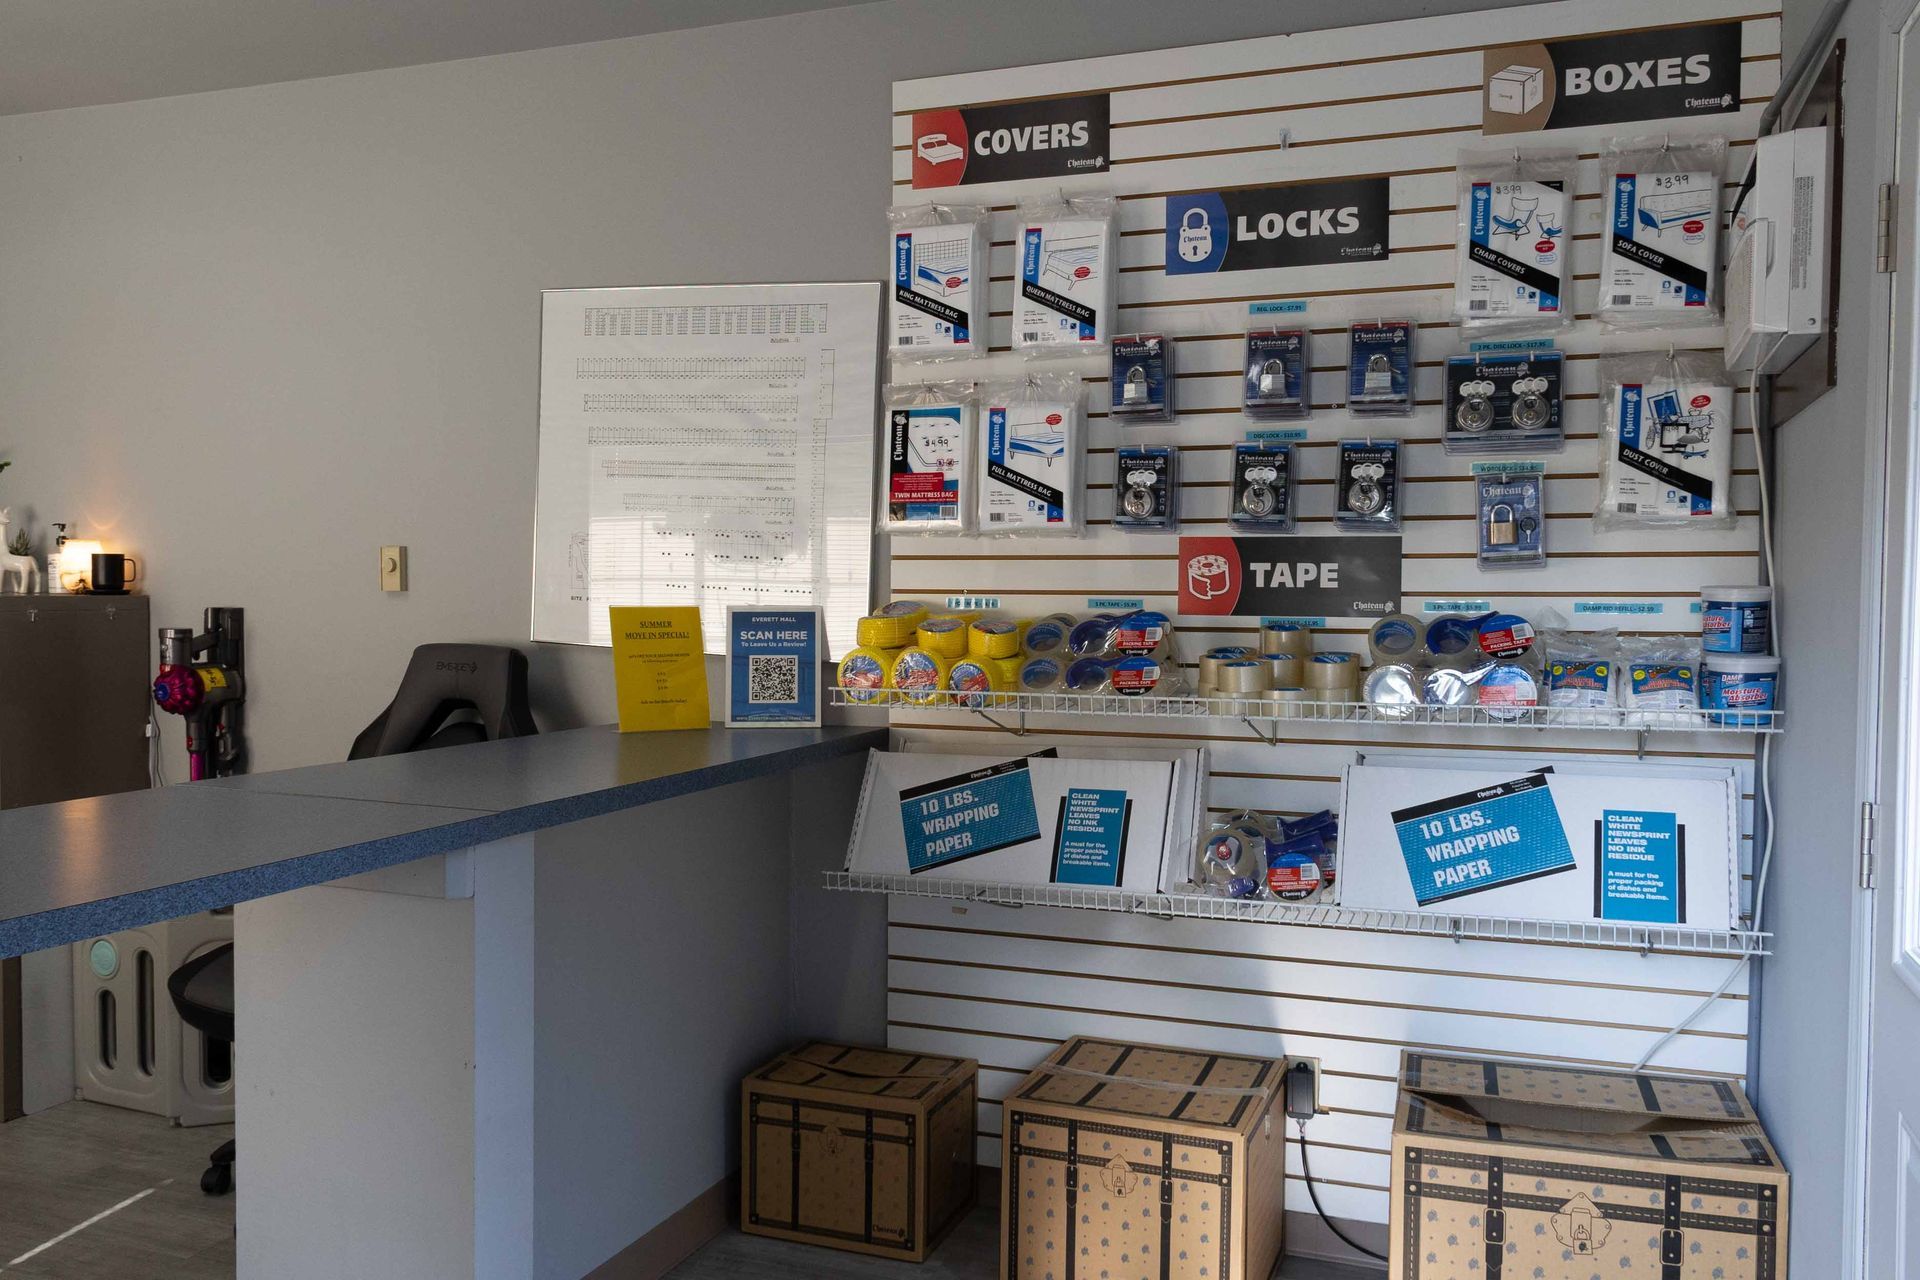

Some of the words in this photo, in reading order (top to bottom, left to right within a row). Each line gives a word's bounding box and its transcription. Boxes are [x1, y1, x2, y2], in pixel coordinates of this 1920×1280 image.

[1565, 54, 1712, 97] BOXES
[1685, 97, 1721, 109] Chateau
[974, 120, 1089, 156] COVERS
[1067, 157, 1094, 168] Chateau
[1474, 201, 1484, 236] Chateau
[1618, 192, 1628, 228] Chateau
[1236, 206, 1360, 242] LOCKS
[1026, 246, 1035, 276] Chateau
[1340, 247, 1372, 256] Chateau
[1474, 247, 1496, 261] CHAIR
[1498, 256, 1526, 275] COVERS
[1617, 239, 1637, 253] SOFA
[1640, 248, 1664, 264] COVER
[899, 290, 914, 300] KING
[914, 296, 945, 314] MATTRESS
[945, 307, 958, 319] BAG
[1026, 285, 1044, 298] QUEEN
[1044, 291, 1077, 312] MATTRESS
[1076, 306, 1090, 319] BAG
[1251, 338, 1287, 350] Chateau
[1355, 331, 1392, 343] Chateau
[1115, 346, 1148, 356] Chateau
[1476, 365, 1517, 377] Chateau
[1624, 402, 1634, 437] Chateau
[894, 426, 903, 461] Chateau
[992, 423, 1000, 456] Chateau
[1122, 458, 1154, 467] Chateau
[1240, 455, 1274, 466] Chateau
[1344, 451, 1381, 462] Chateau
[1623, 448, 1643, 462] DUST
[1644, 458, 1669, 474] COVER
[992, 466, 1006, 478] FULL
[1006, 470, 1038, 492] MATTRESS
[1038, 485, 1052, 497] BAG
[1483, 487, 1522, 497] Chateau
[1250, 562, 1339, 588] TAPE
[1354, 601, 1385, 612] Chateau
[740, 631, 773, 640] SCAN
[777, 631, 808, 640] HERE
[1723, 688, 1762, 696] Moisture
[1729, 693, 1768, 702] Absorber
[920, 800, 939, 816] 10
[945, 790, 979, 809] LBS.
[1070, 806, 1120, 814] NEWSPRINT
[922, 803, 1000, 836] WRAPPING
[1420, 820, 1444, 840] 10
[1448, 810, 1492, 833] LBS.
[926, 832, 973, 857] PAPER
[1425, 826, 1521, 863] WRAPPING
[1608, 830, 1671, 839] NEWSPRINT
[1608, 838, 1648, 846] LEAVES
[1608, 853, 1655, 862] RESIDUE
[1433, 860, 1493, 888] PAPER
[1634, 880, 1664, 888] packing
